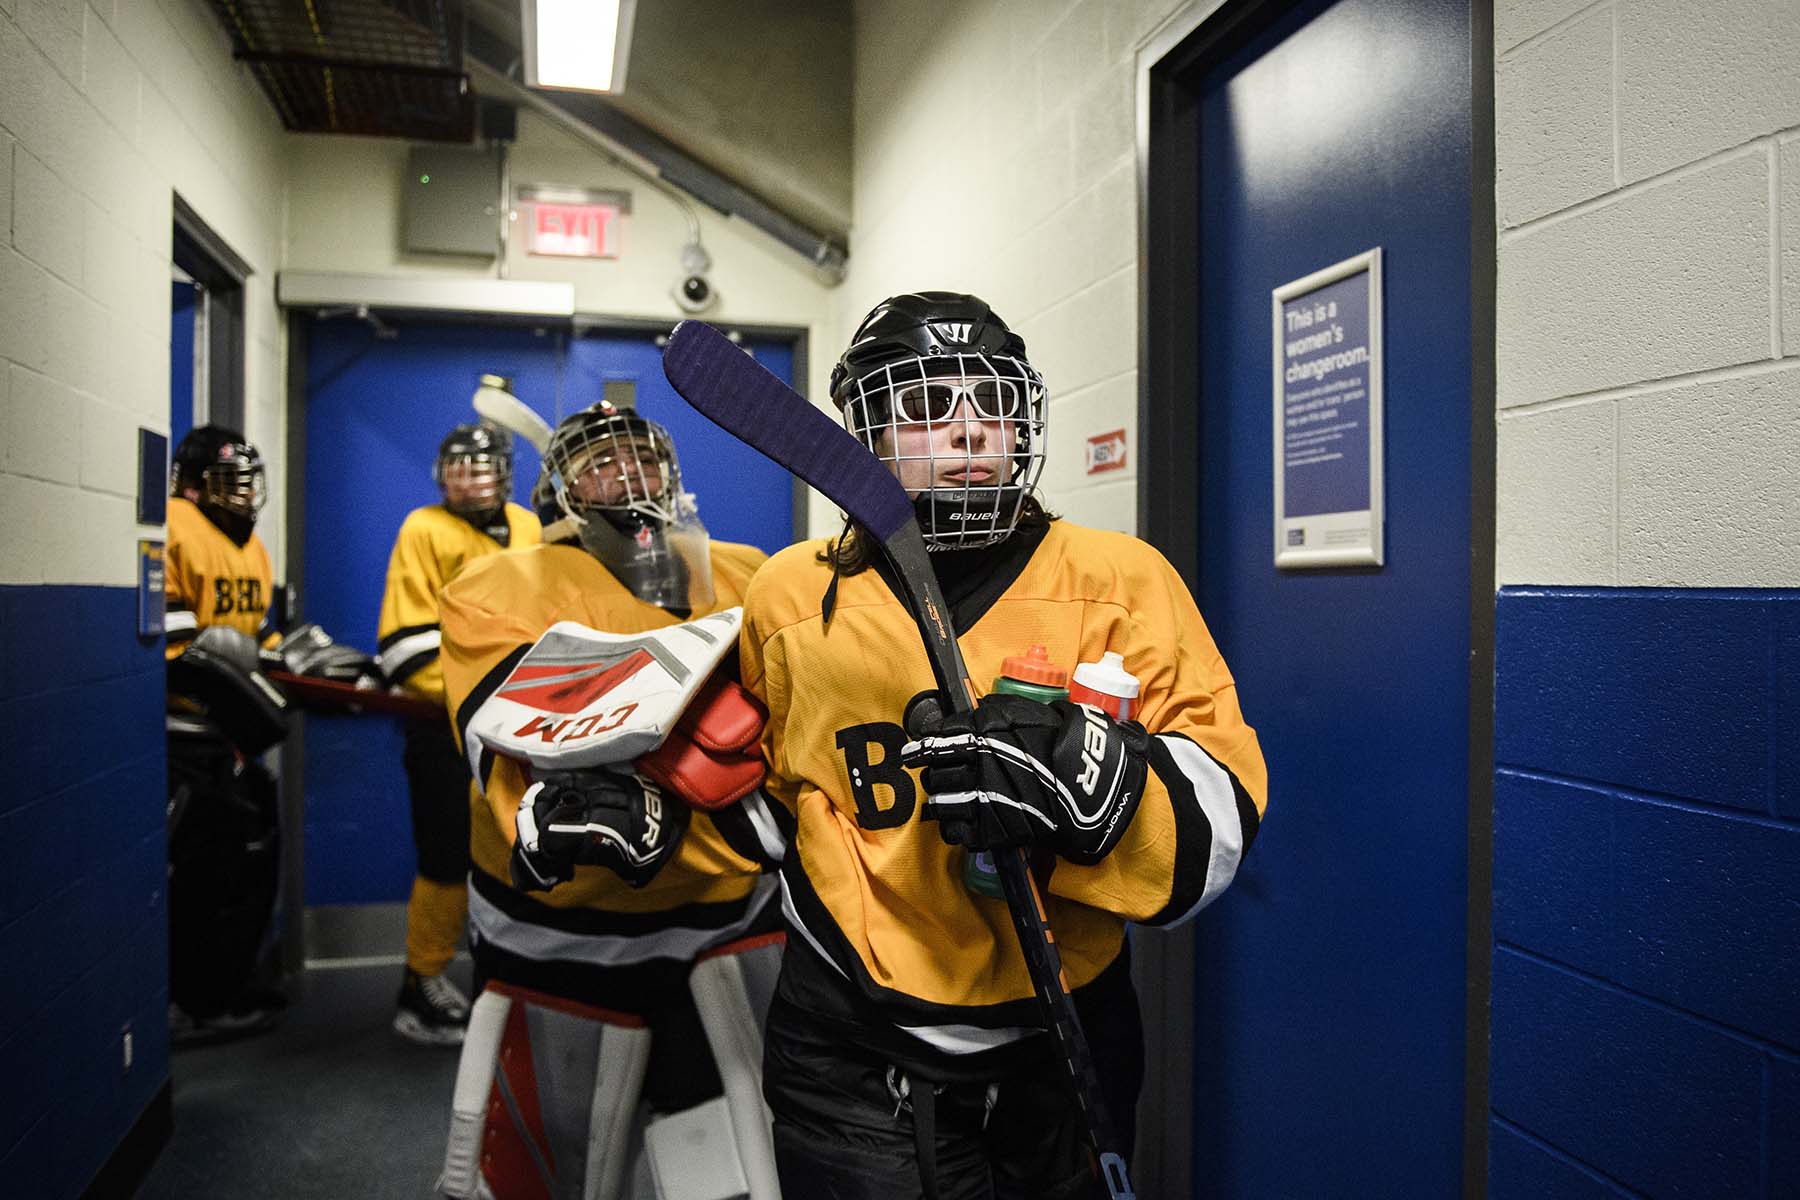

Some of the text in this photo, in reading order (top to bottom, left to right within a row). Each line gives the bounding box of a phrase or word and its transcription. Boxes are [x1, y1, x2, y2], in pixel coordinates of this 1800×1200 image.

[535, 205, 612, 256] EXIT
[1286, 301, 1337, 332] This is a
[1286, 323, 1344, 358] women's
[513, 702, 639, 743] CCM
[1075, 703, 1109, 796] UER
[835, 721, 934, 831] B
[640, 774, 663, 849] UER
[1105, 792, 1132, 835] VAPOR
